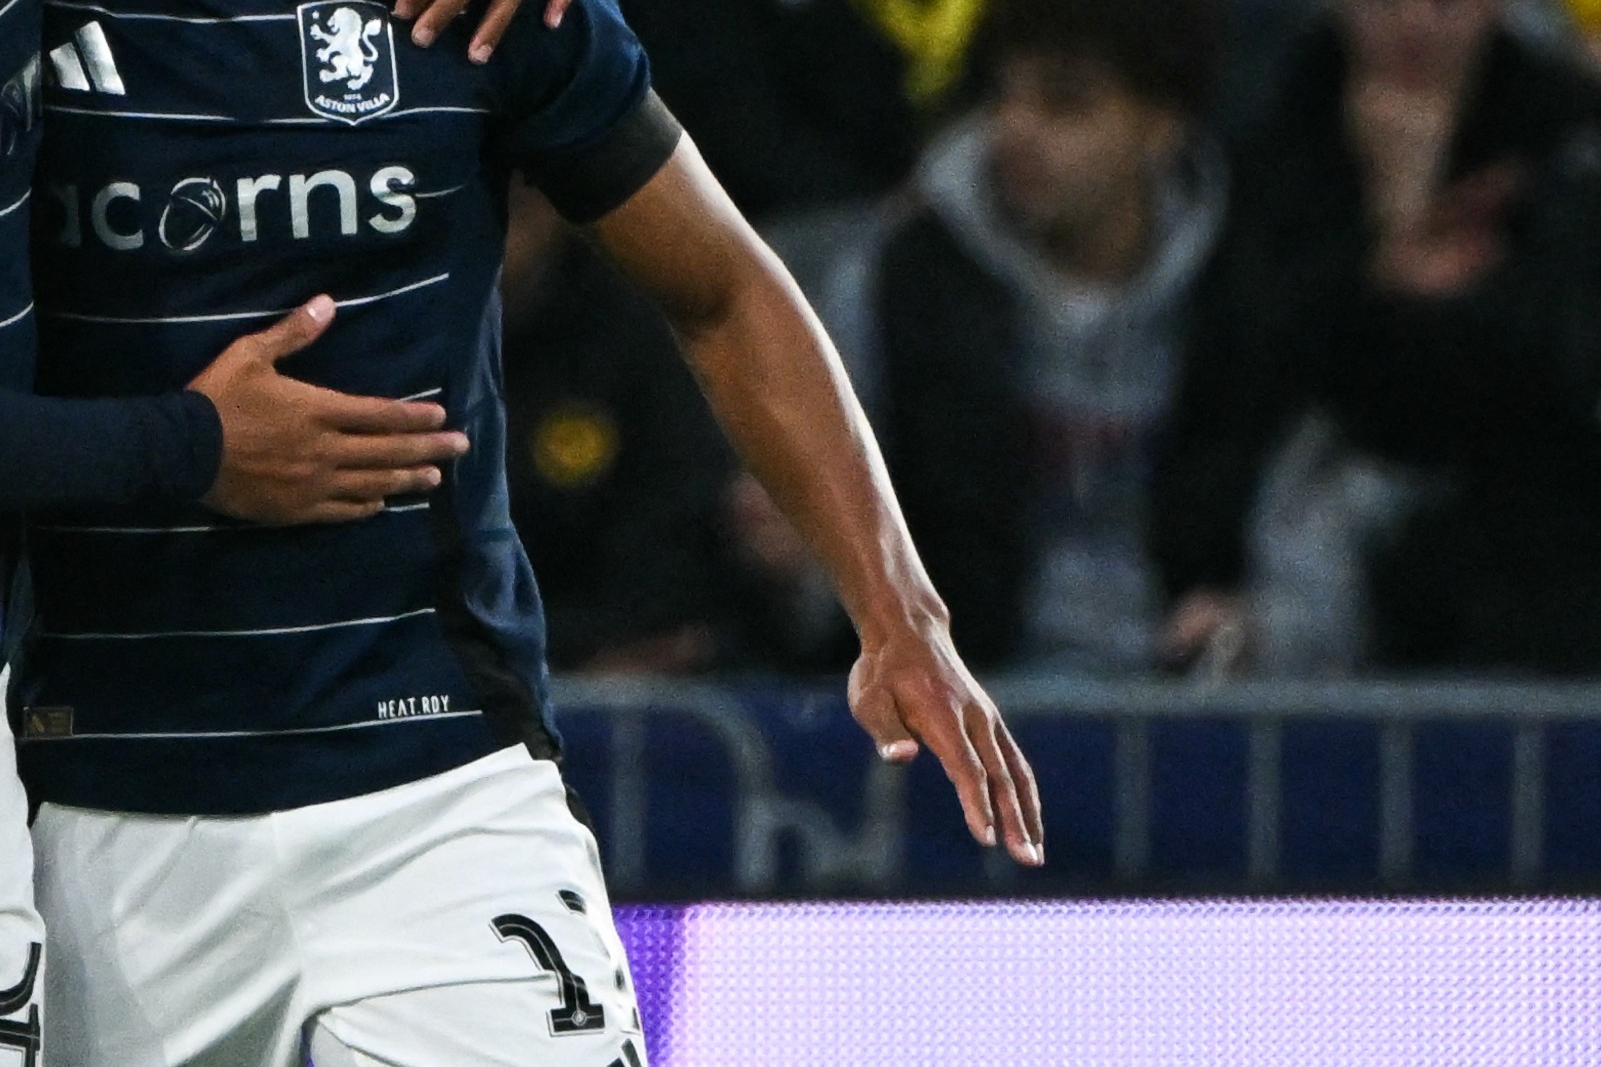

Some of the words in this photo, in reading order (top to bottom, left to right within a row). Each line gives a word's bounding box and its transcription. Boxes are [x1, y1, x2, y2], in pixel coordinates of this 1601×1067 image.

[314, 94, 356, 113] ASTON
[356, 92, 391, 112] VILLA
[377, 694, 450, 719] HEAT.RDY
